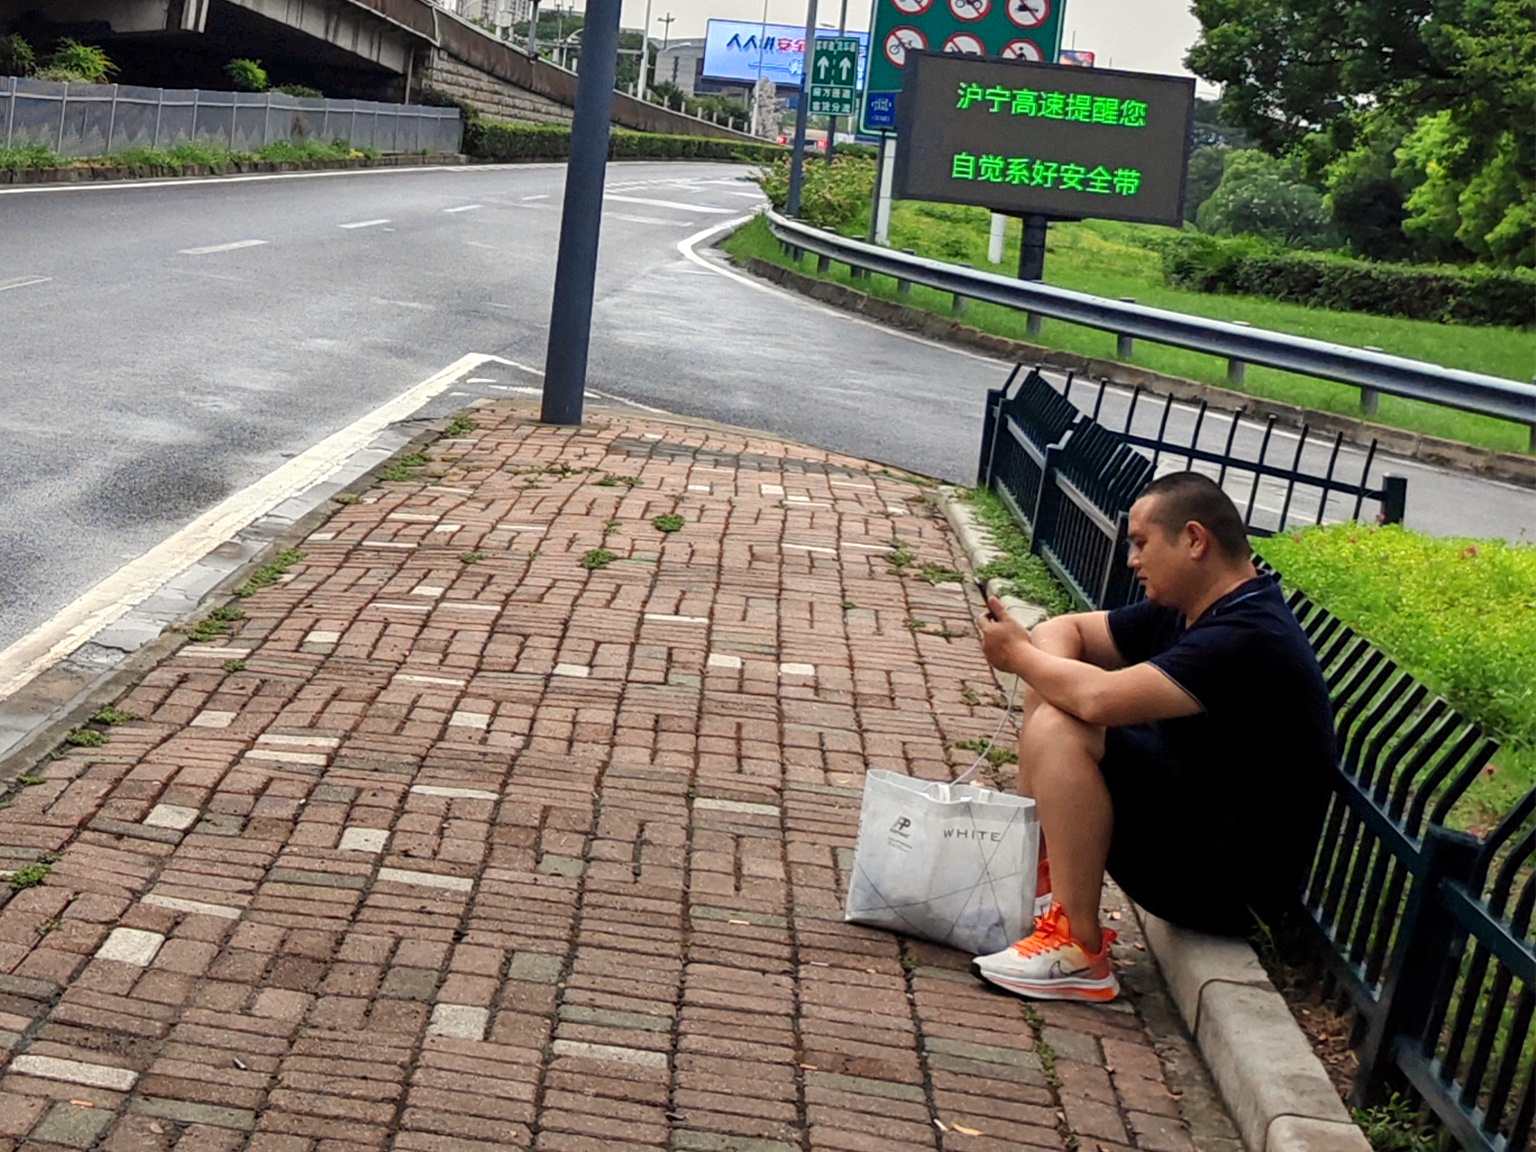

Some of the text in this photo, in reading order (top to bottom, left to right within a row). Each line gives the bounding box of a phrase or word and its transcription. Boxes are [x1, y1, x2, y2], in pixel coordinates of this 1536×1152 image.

[956, 82, 1149, 127] 沪宁高速提醒您
[951, 151, 1142, 196] 自觉系好安全带
[943, 828, 1001, 842] WHITE
